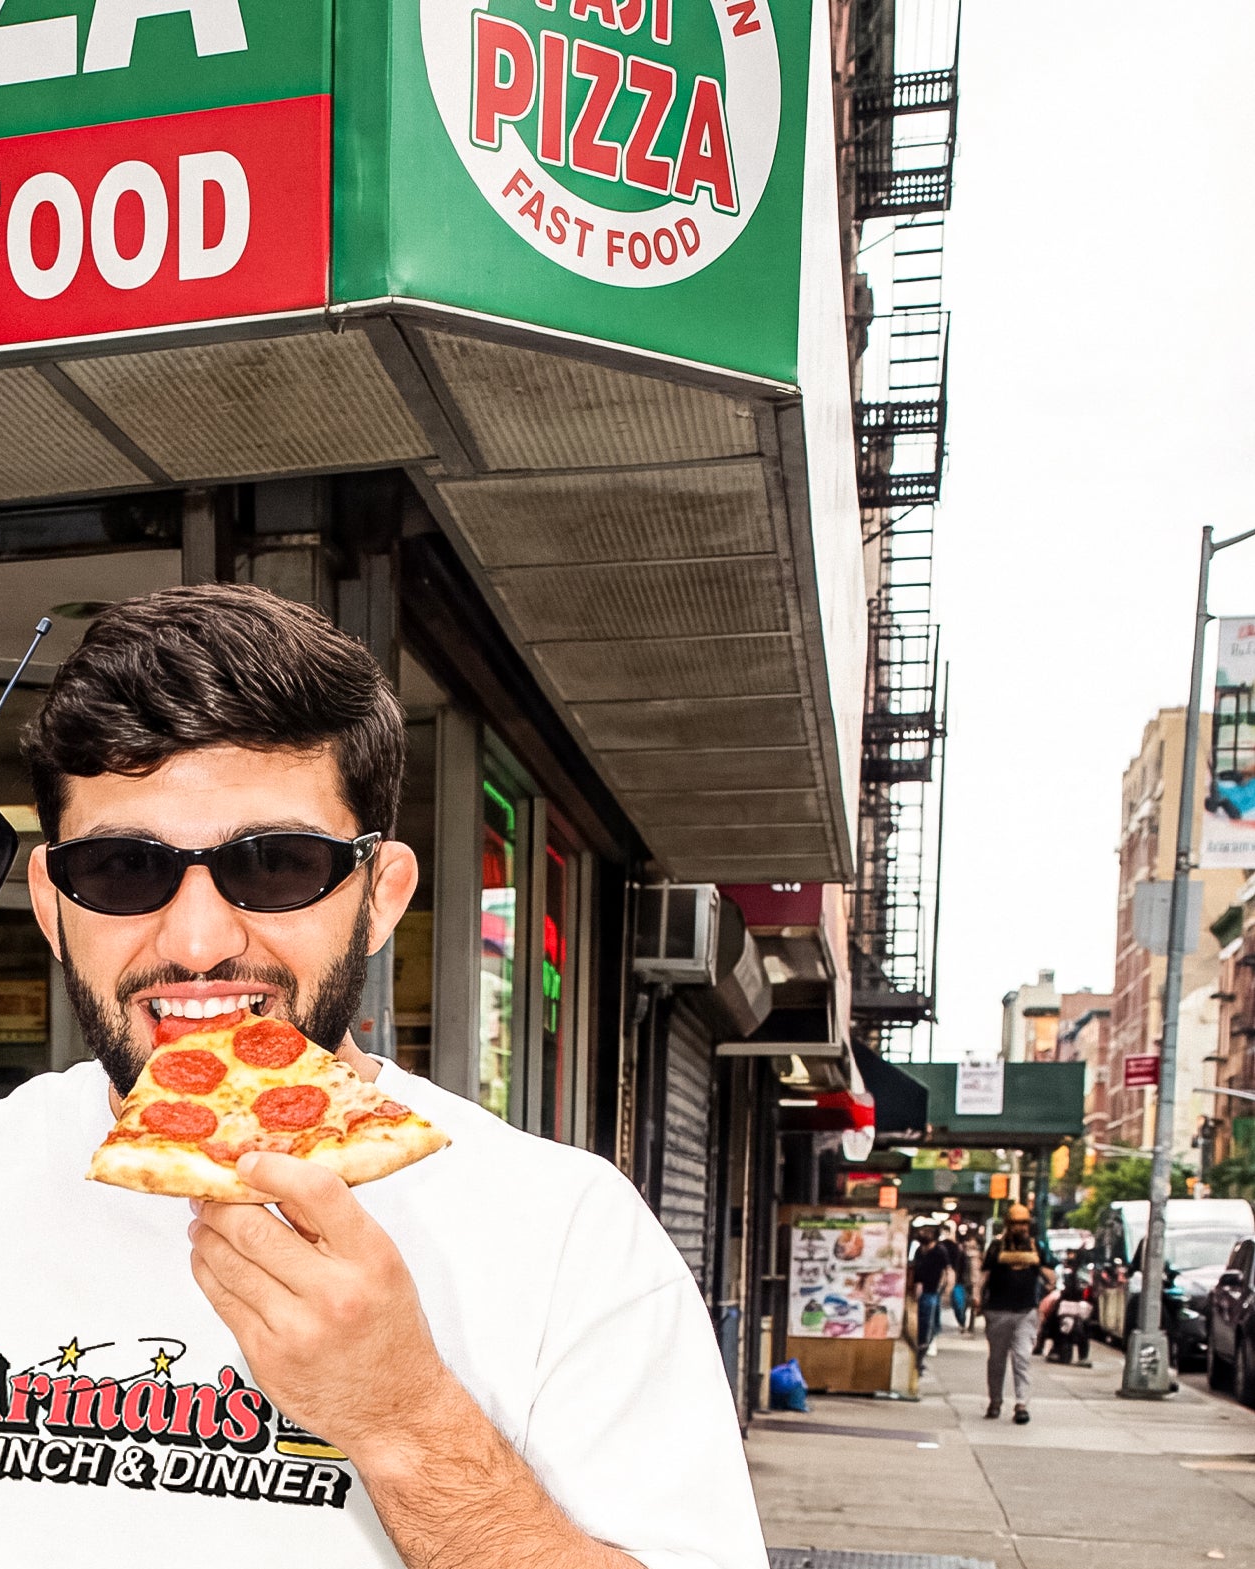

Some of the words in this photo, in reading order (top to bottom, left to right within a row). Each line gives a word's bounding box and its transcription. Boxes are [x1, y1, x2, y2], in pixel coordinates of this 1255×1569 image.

[473, 13, 738, 212] PIZZA
[501, 168, 595, 258] FAST
[606, 217, 701, 270] FOOD
[114, 1444, 155, 1489] &
[162, 1449, 352, 1508] DINNER
